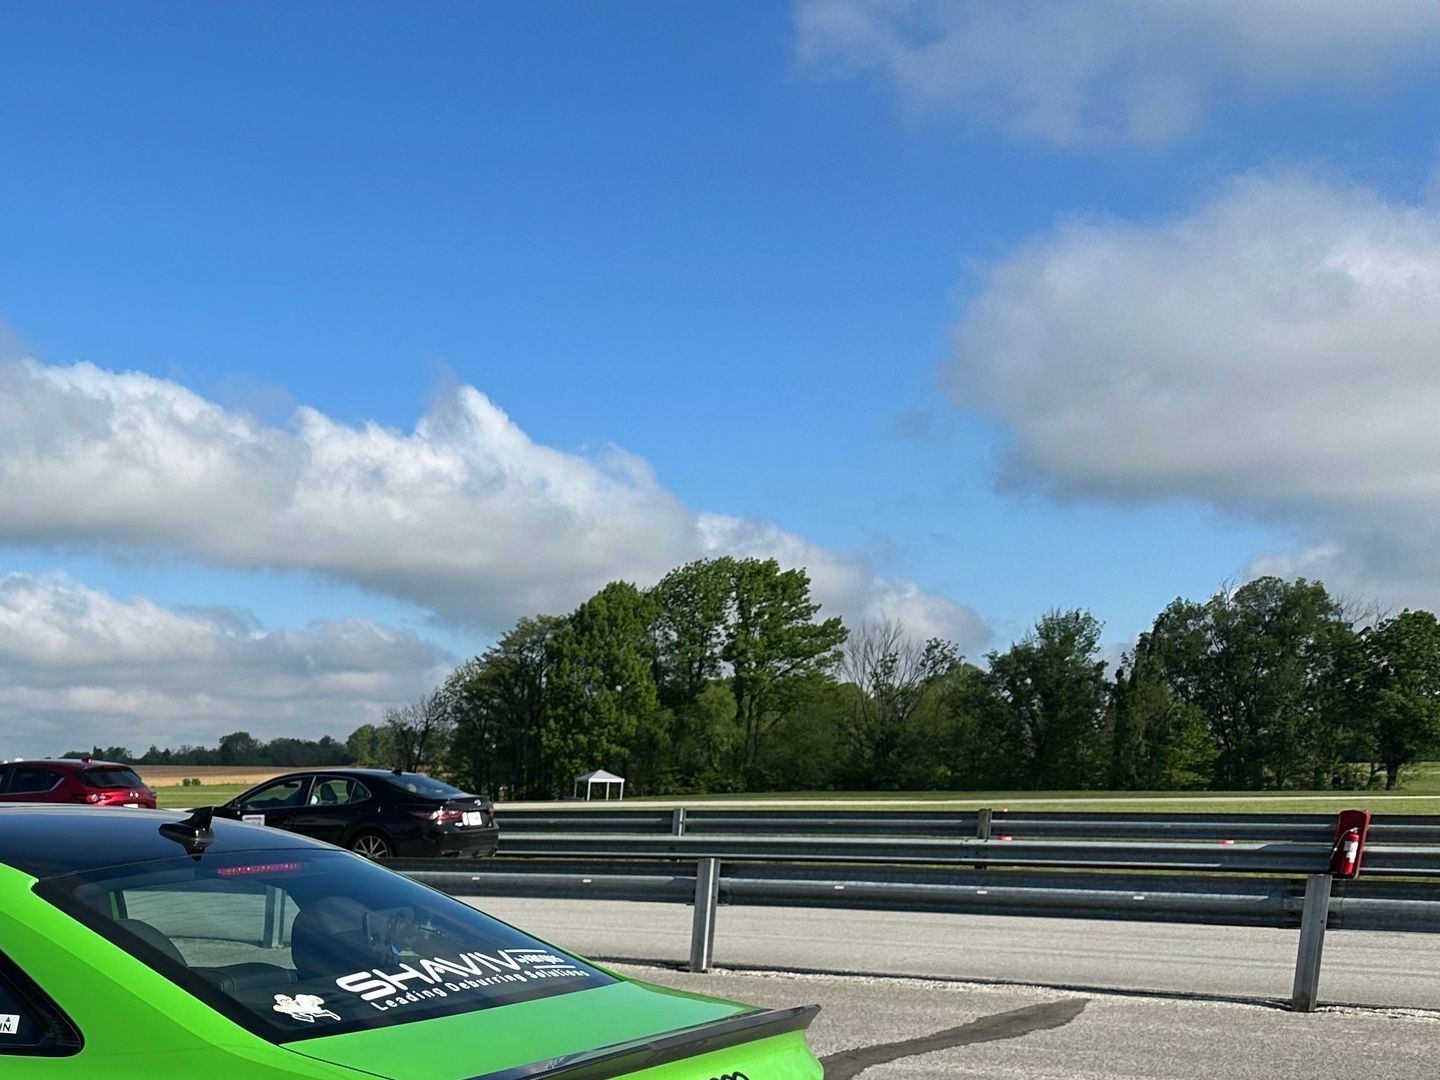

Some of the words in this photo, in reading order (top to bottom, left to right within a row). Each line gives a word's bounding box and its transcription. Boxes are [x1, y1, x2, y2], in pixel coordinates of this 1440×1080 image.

[335, 950, 521, 1001] SHAVIV
[370, 985, 448, 1011] Leading
[444, 971, 527, 993] Deburring
[523, 968, 590, 980] Solutions
